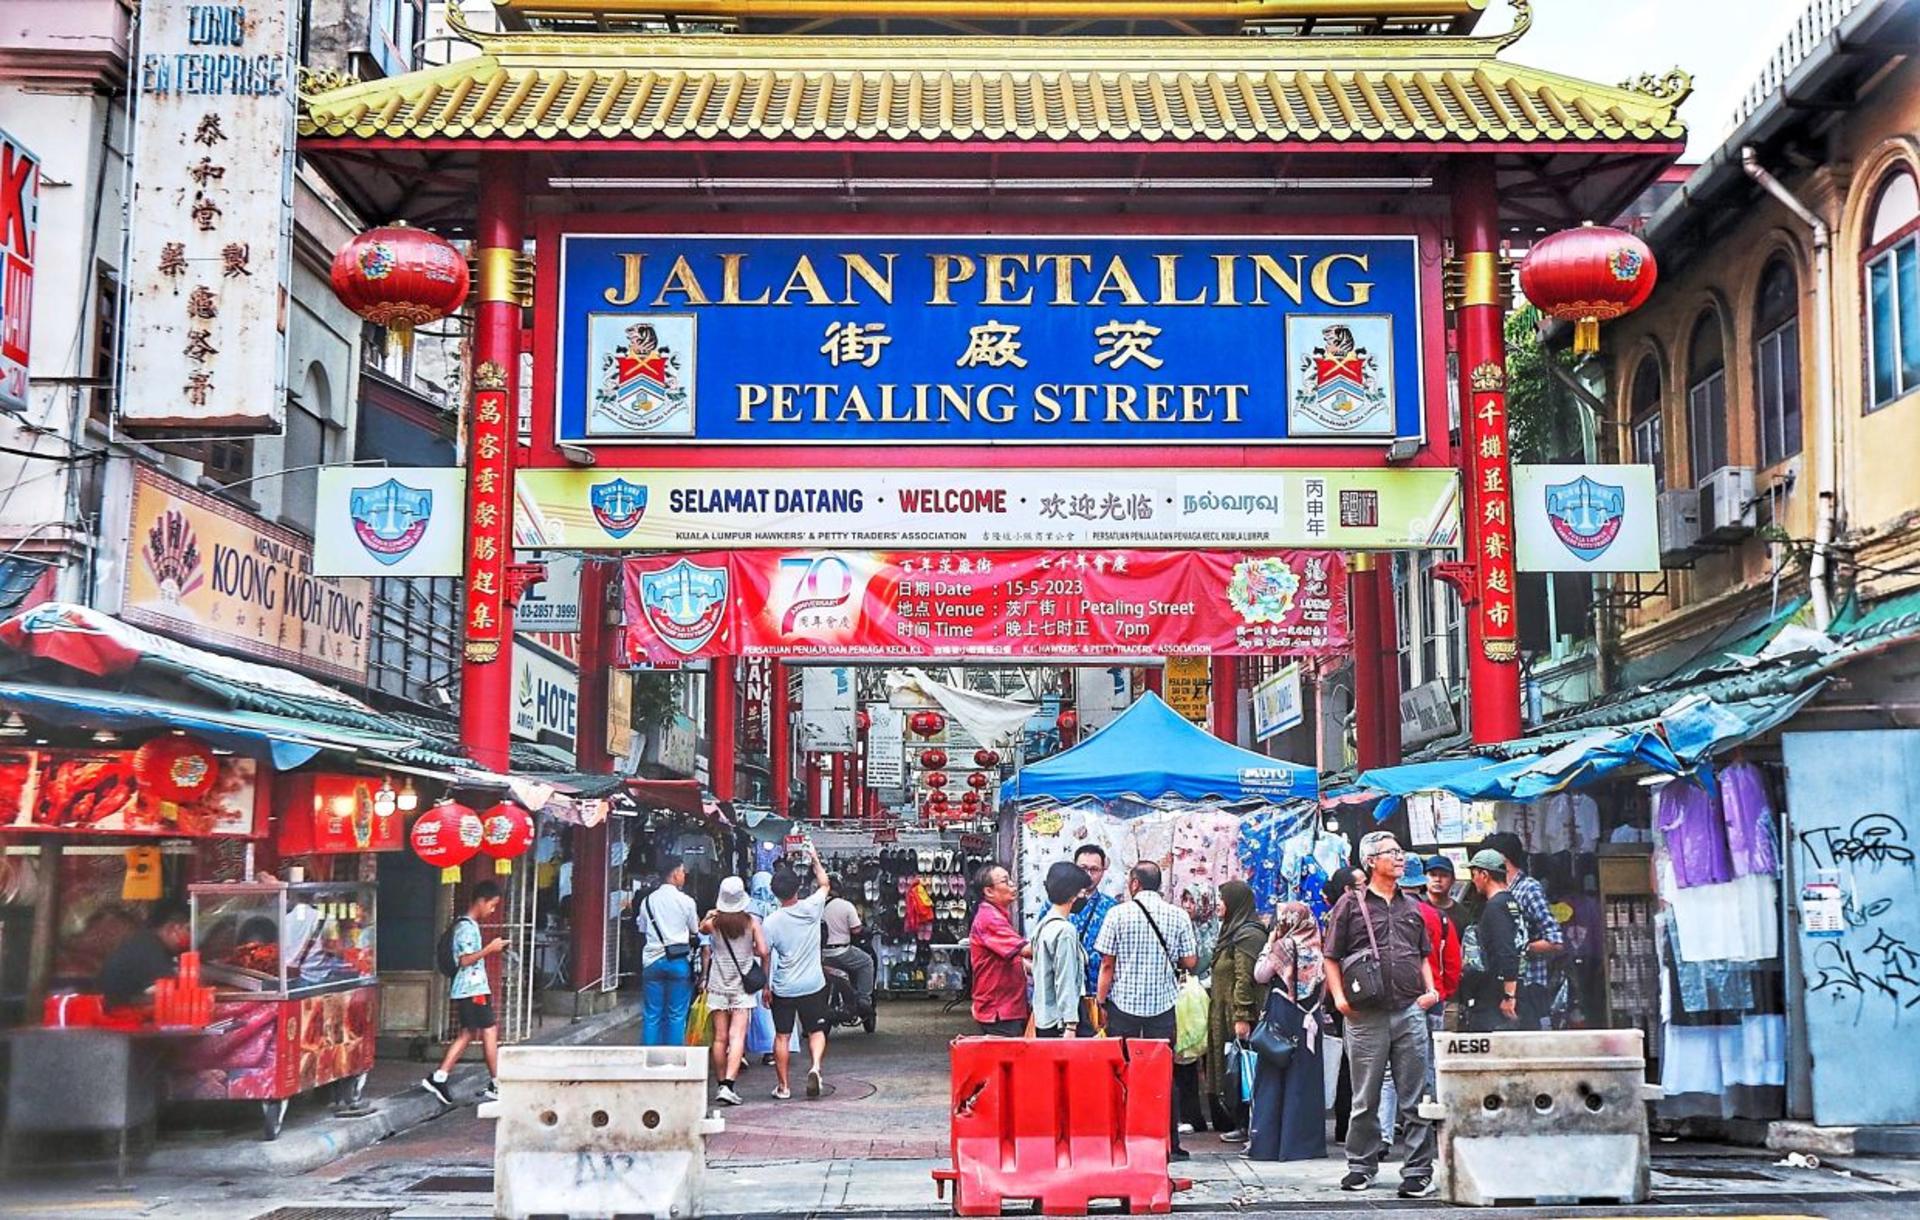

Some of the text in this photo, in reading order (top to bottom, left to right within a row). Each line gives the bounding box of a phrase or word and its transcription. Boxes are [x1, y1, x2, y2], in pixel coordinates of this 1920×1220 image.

[143, 53, 283, 95] ENTERPRISE
[604, 252, 1376, 307] JALAN PETALING
[736, 384, 1249, 423] PETALING STREET
[670, 488, 770, 513] SELAMAT
[775, 488, 863, 513] DATANG
[898, 489, 1007, 513] WELCOME
[1039, 491, 1153, 521] 欢迎光临
[1183, 490, 1279, 516] நல்வரவு
[676, 531, 709, 540] KUALA
[712, 531, 752, 540] LUMPUR
[808, 531, 816, 540] &
[818, 531, 848, 540] PETTY
[901, 531, 967, 540] ASSOCIATION
[1092, 532, 1130, 541] PERSATUAN
[1159, 532, 1173, 541] DAN
[212, 543, 277, 611] KOONG
[283, 571, 324, 626] WOH
[326, 587, 364, 641] TONG
[899, 580, 1084, 597] 日期 Date 15-5-2023
[521, 604, 553, 618] 03-2857
[897, 599, 1195, 617] 地点 Venue 茨厂街 Petaling Street
[897, 620, 1150, 638] 时间 Time 晚上七时正 7pm
[744, 645, 790, 654] PERSATUAN
[828, 645, 848, 654] DAN
[1157, 644, 1212, 654] ASSOCIATION
[536, 678, 577, 736] HOTE
[1447, 1038, 1490, 1054] AESB
